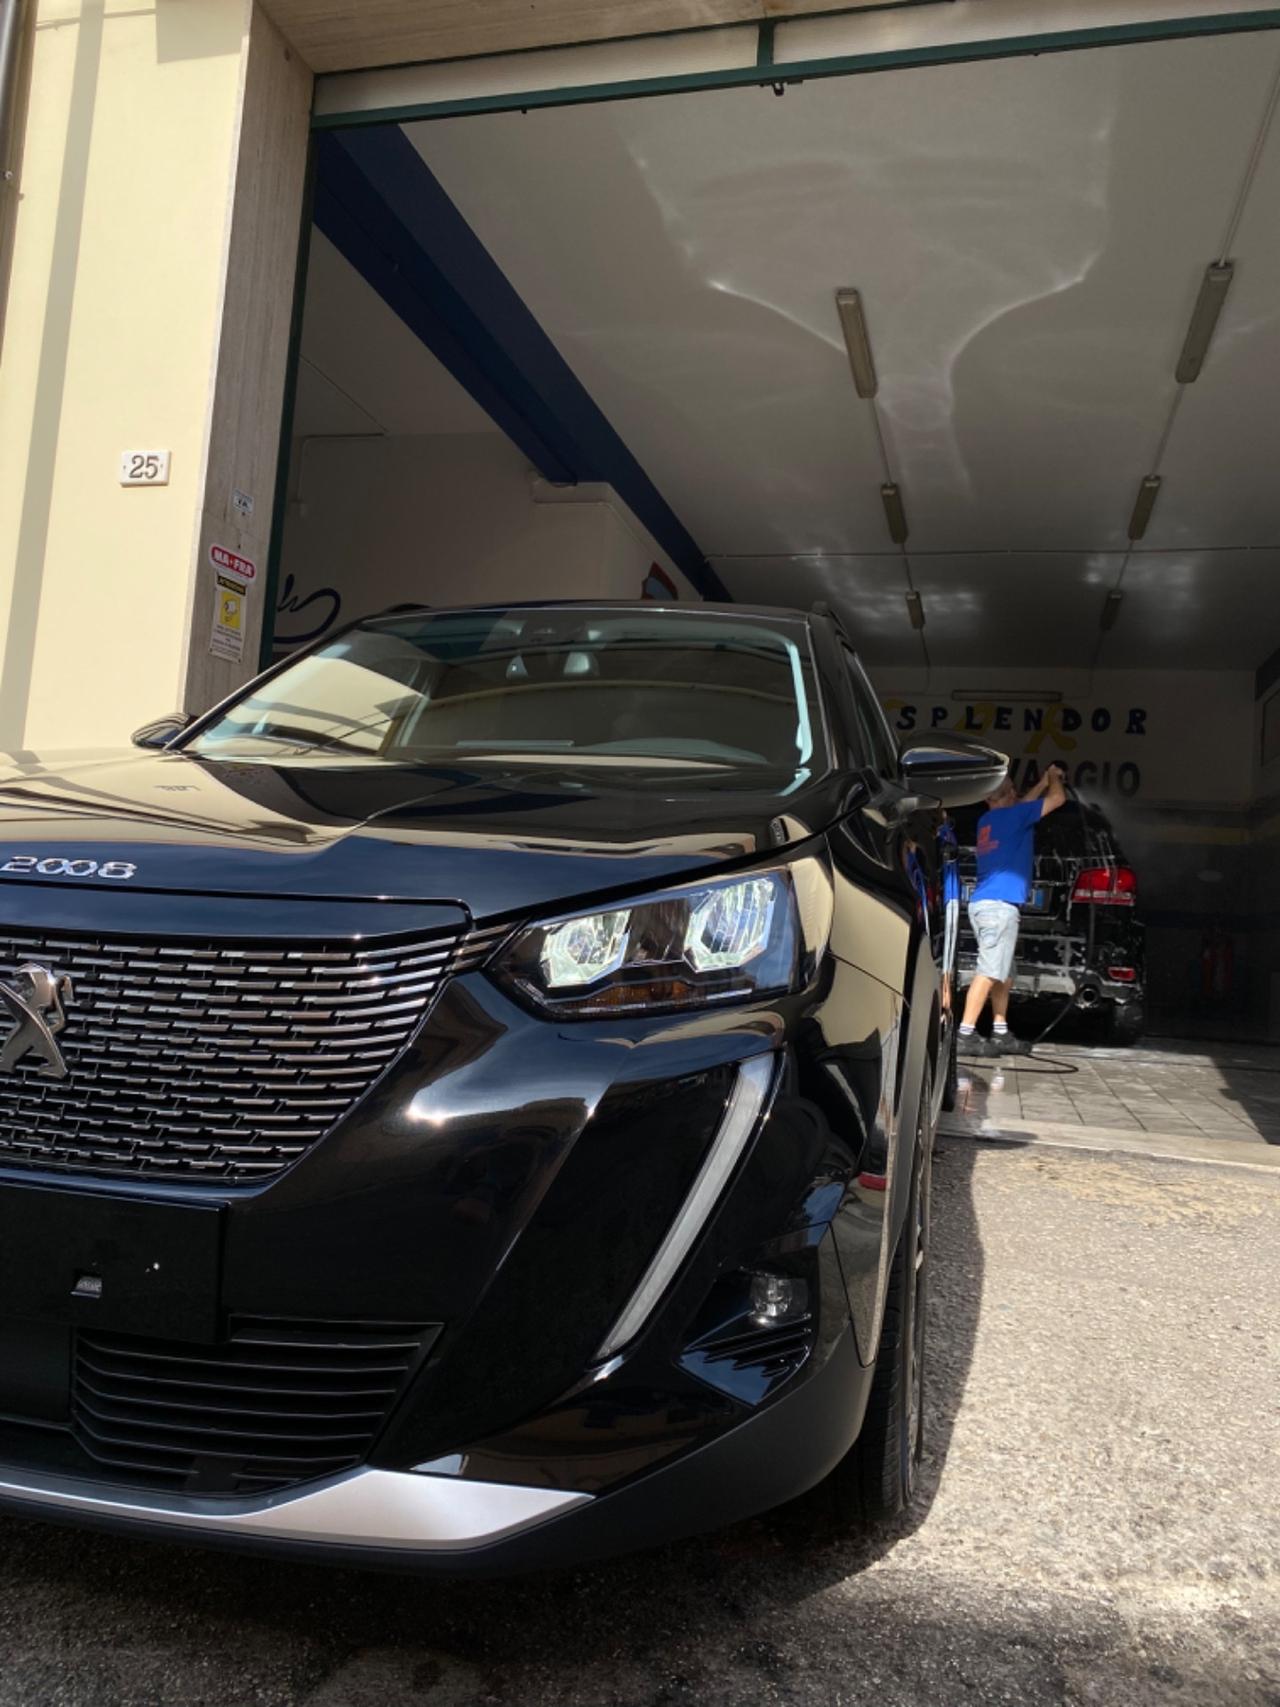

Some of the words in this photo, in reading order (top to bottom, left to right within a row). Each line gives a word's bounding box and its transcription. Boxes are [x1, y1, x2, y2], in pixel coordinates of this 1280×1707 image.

[128, 455, 160, 479] 25
[896, 706, 1147, 734] SPLENDOR
[0, 856, 137, 879] 2008
